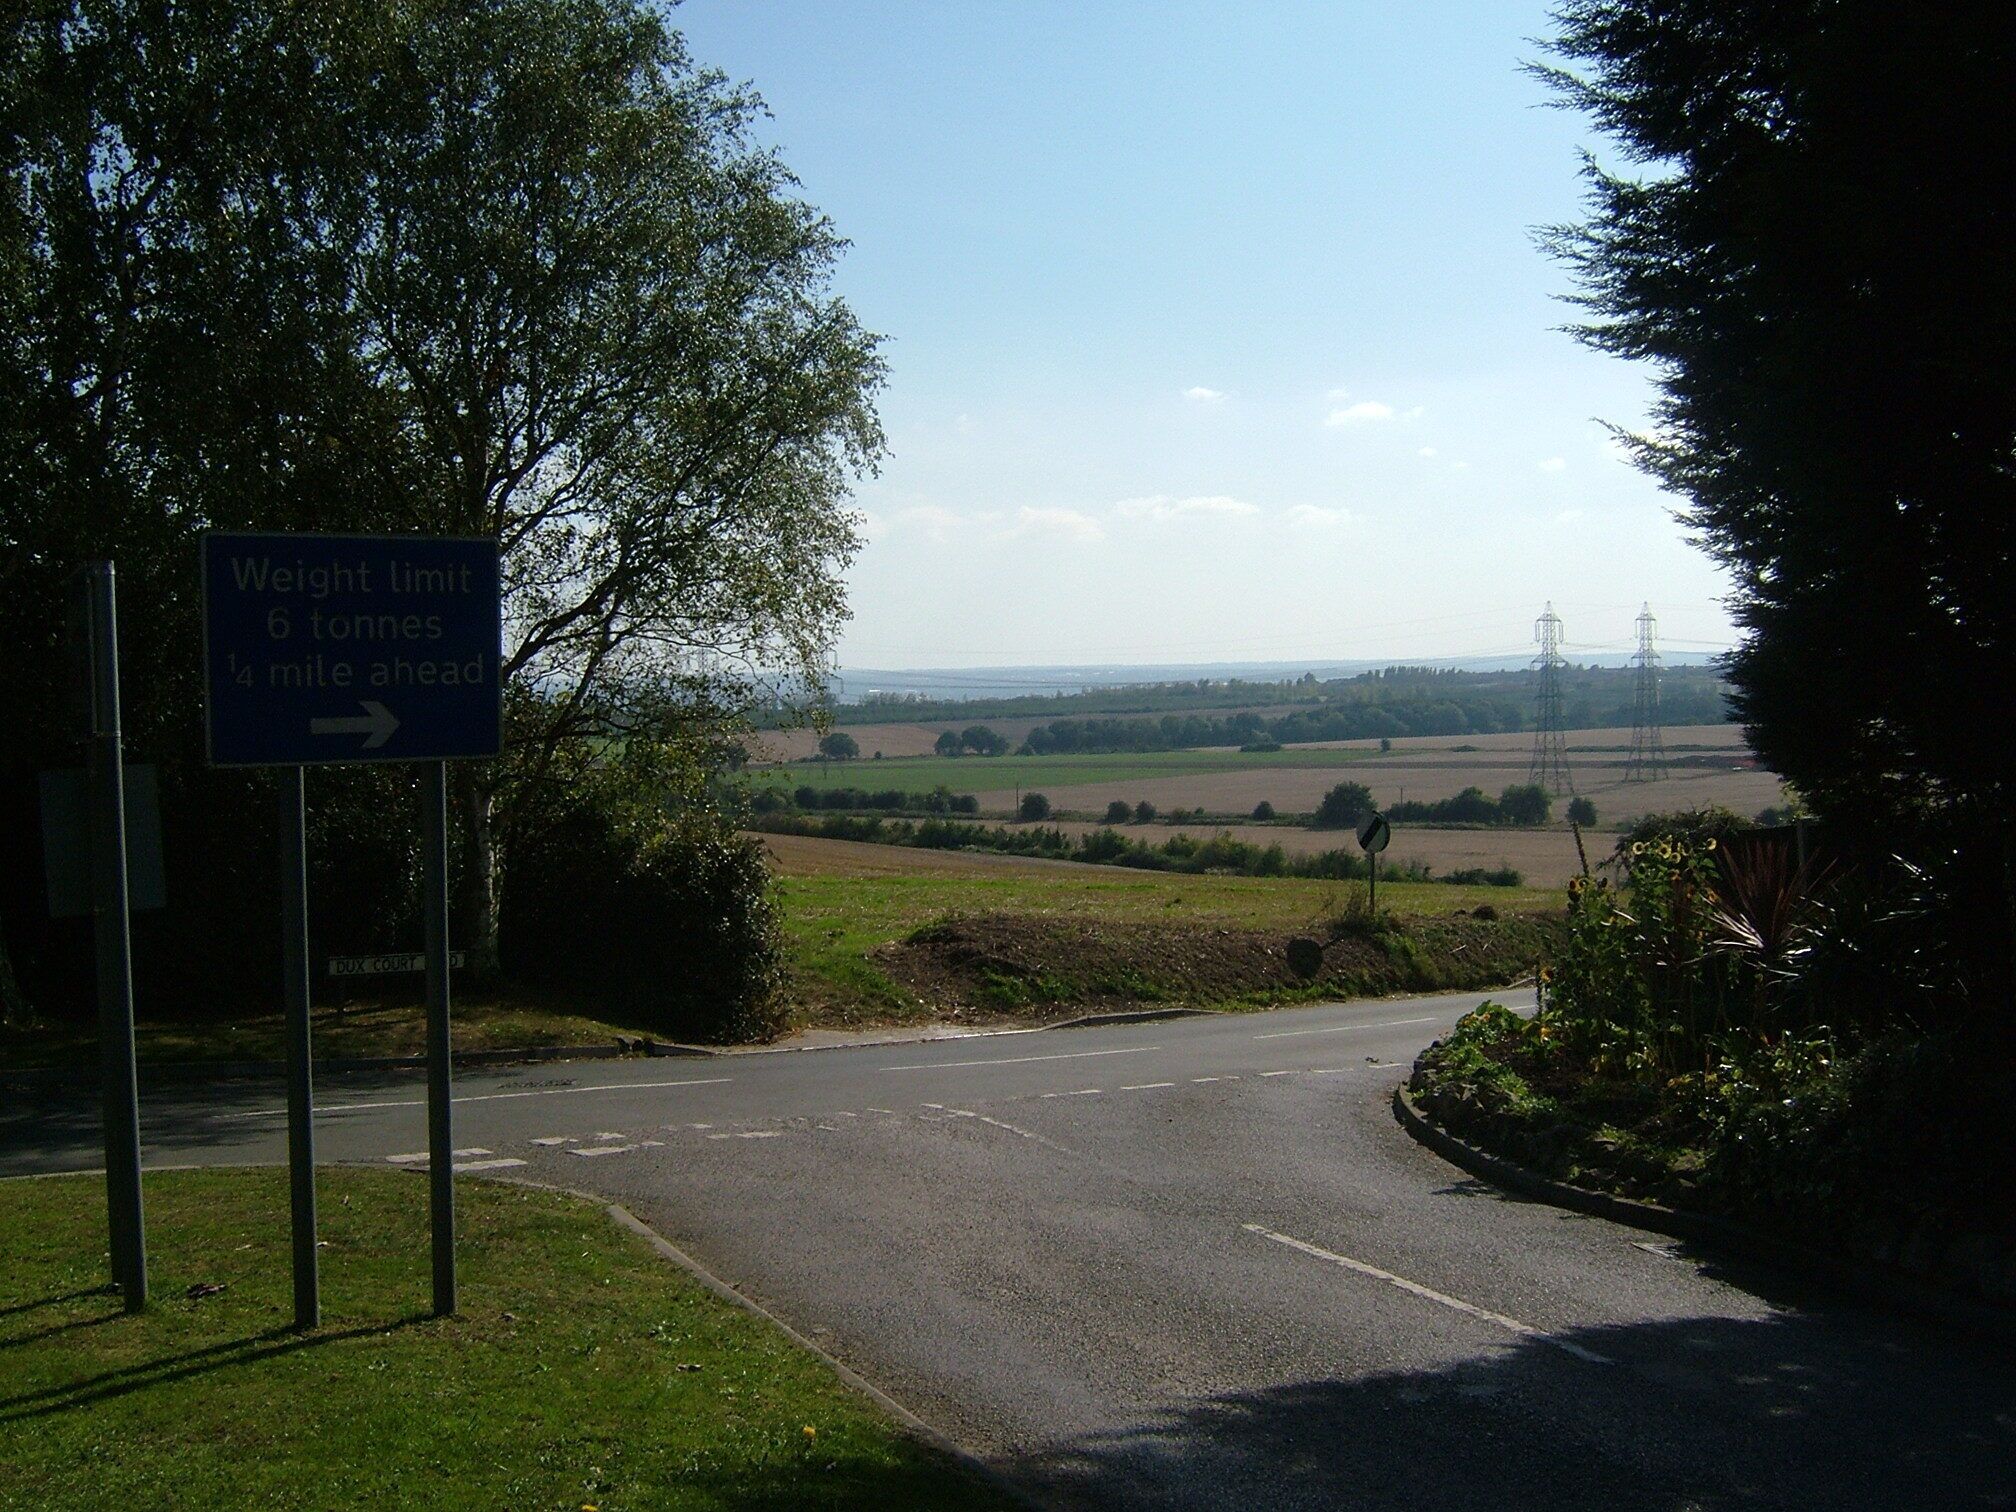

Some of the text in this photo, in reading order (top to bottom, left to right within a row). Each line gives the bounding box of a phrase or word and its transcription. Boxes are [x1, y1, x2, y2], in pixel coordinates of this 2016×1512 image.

[231, 557, 472, 599] Weight limit
[267, 607, 442, 640] 6 tonnes
[270, 654, 353, 687] mile
[370, 653, 484, 686] ahead
[336, 956, 416, 974] DUX COURT
